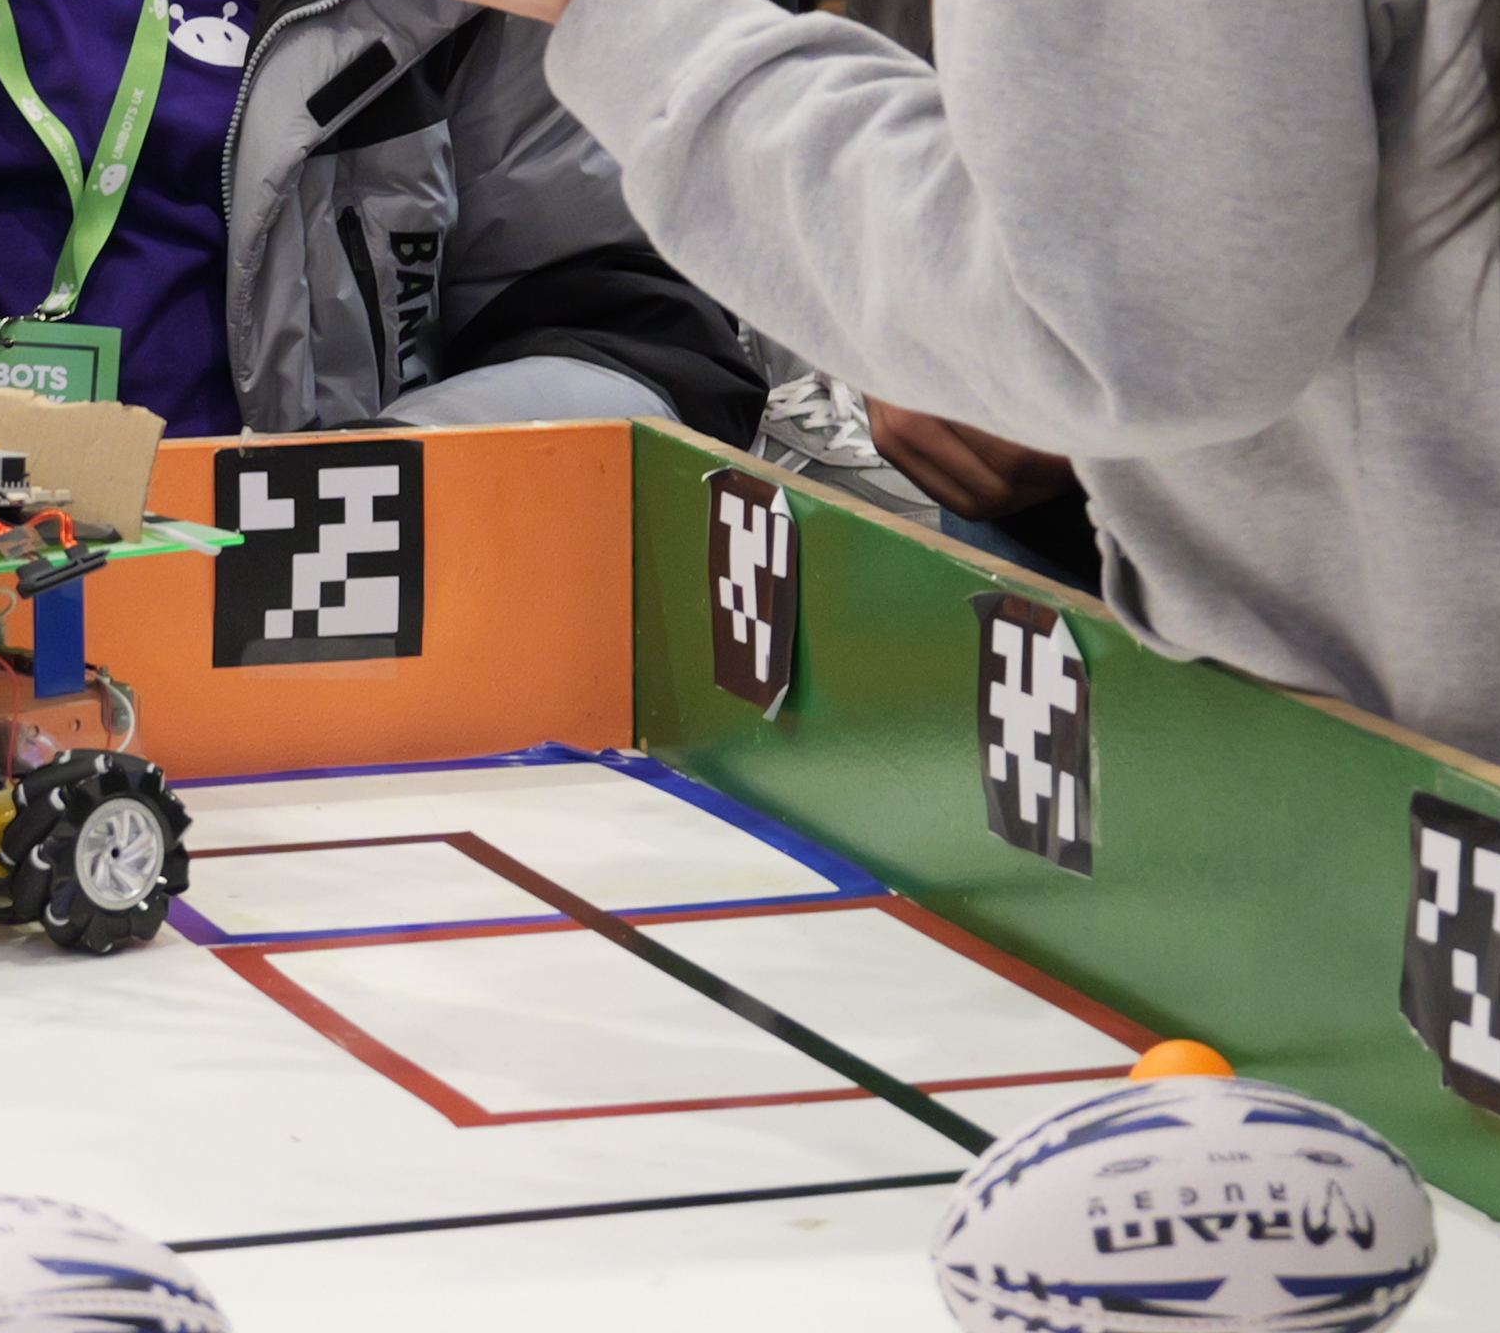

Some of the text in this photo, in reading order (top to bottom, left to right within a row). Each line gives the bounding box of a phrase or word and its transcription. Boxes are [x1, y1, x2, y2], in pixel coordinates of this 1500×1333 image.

[43, 121, 75, 169] UNIBOTS
[111, 87, 146, 160] UNIBOTS UK
[1092, 1210, 1296, 1254] RAM
